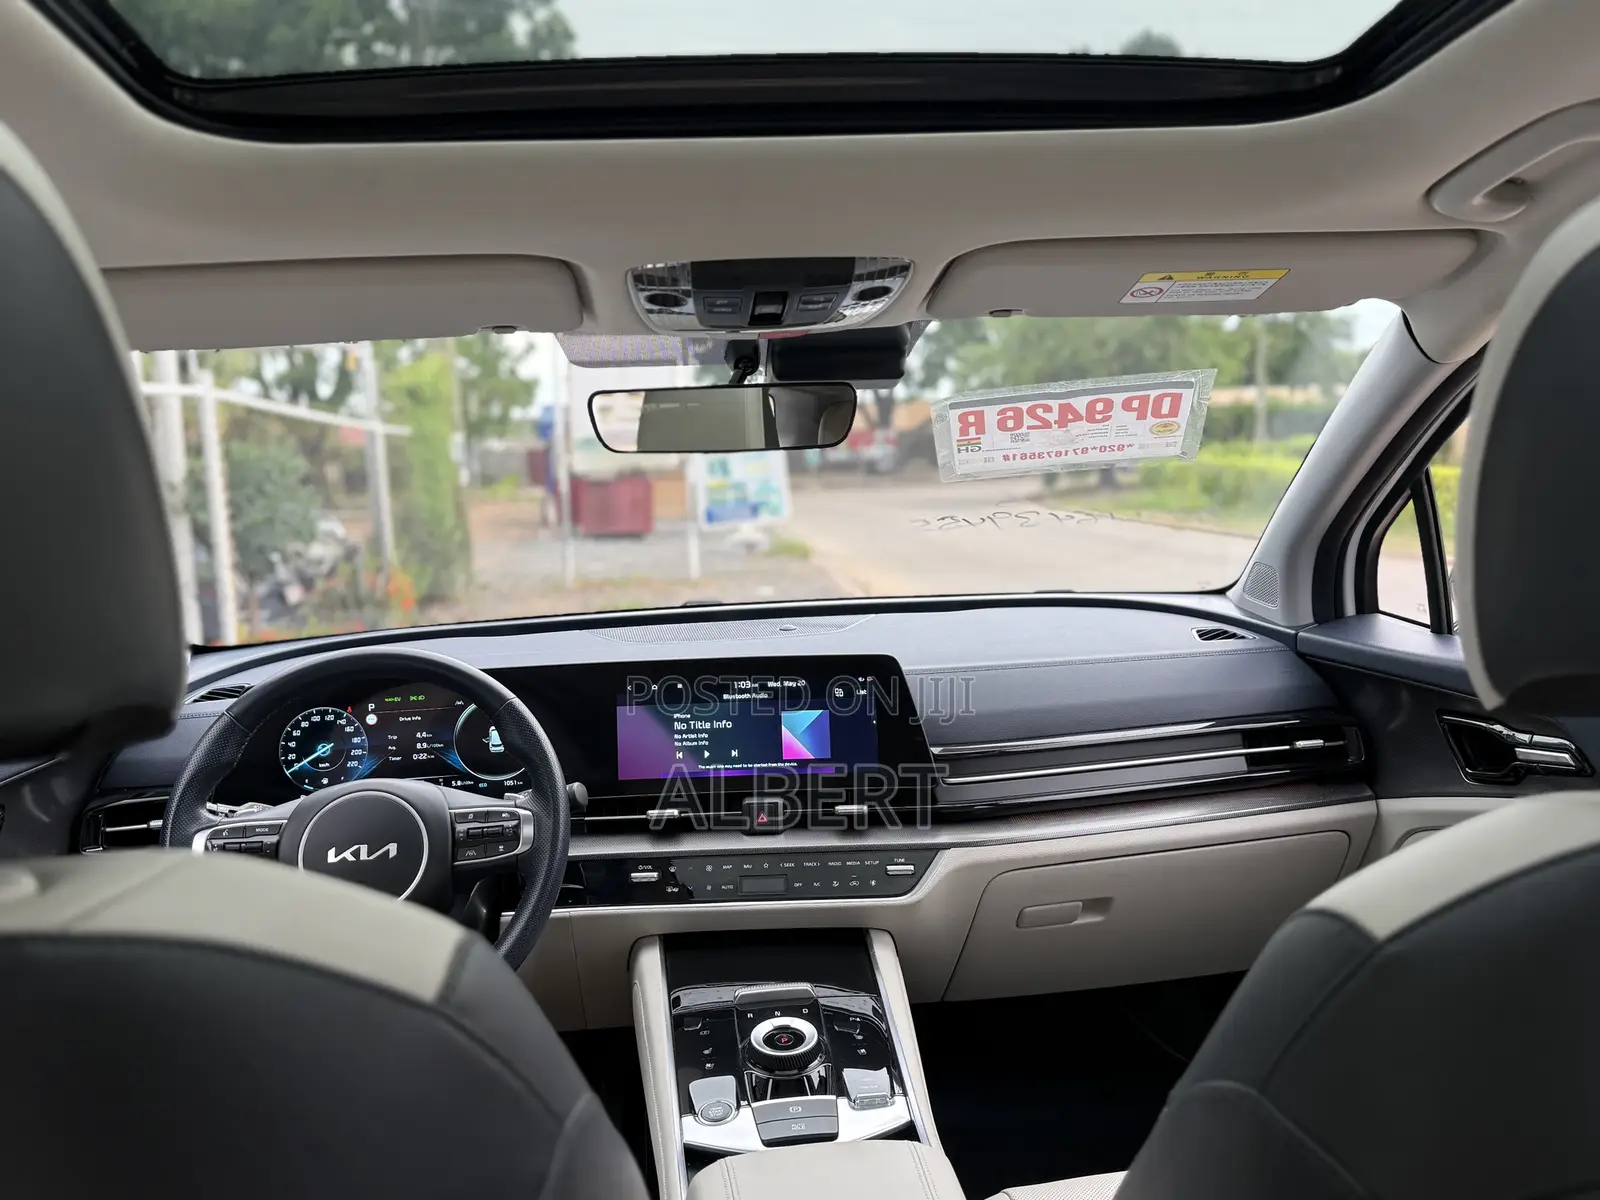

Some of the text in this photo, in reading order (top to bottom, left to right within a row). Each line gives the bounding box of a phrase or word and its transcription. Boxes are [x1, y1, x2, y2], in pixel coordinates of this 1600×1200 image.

[368, 704, 375, 712] P
[674, 720, 732, 730] No Title Info
[328, 843, 398, 863] KIA
